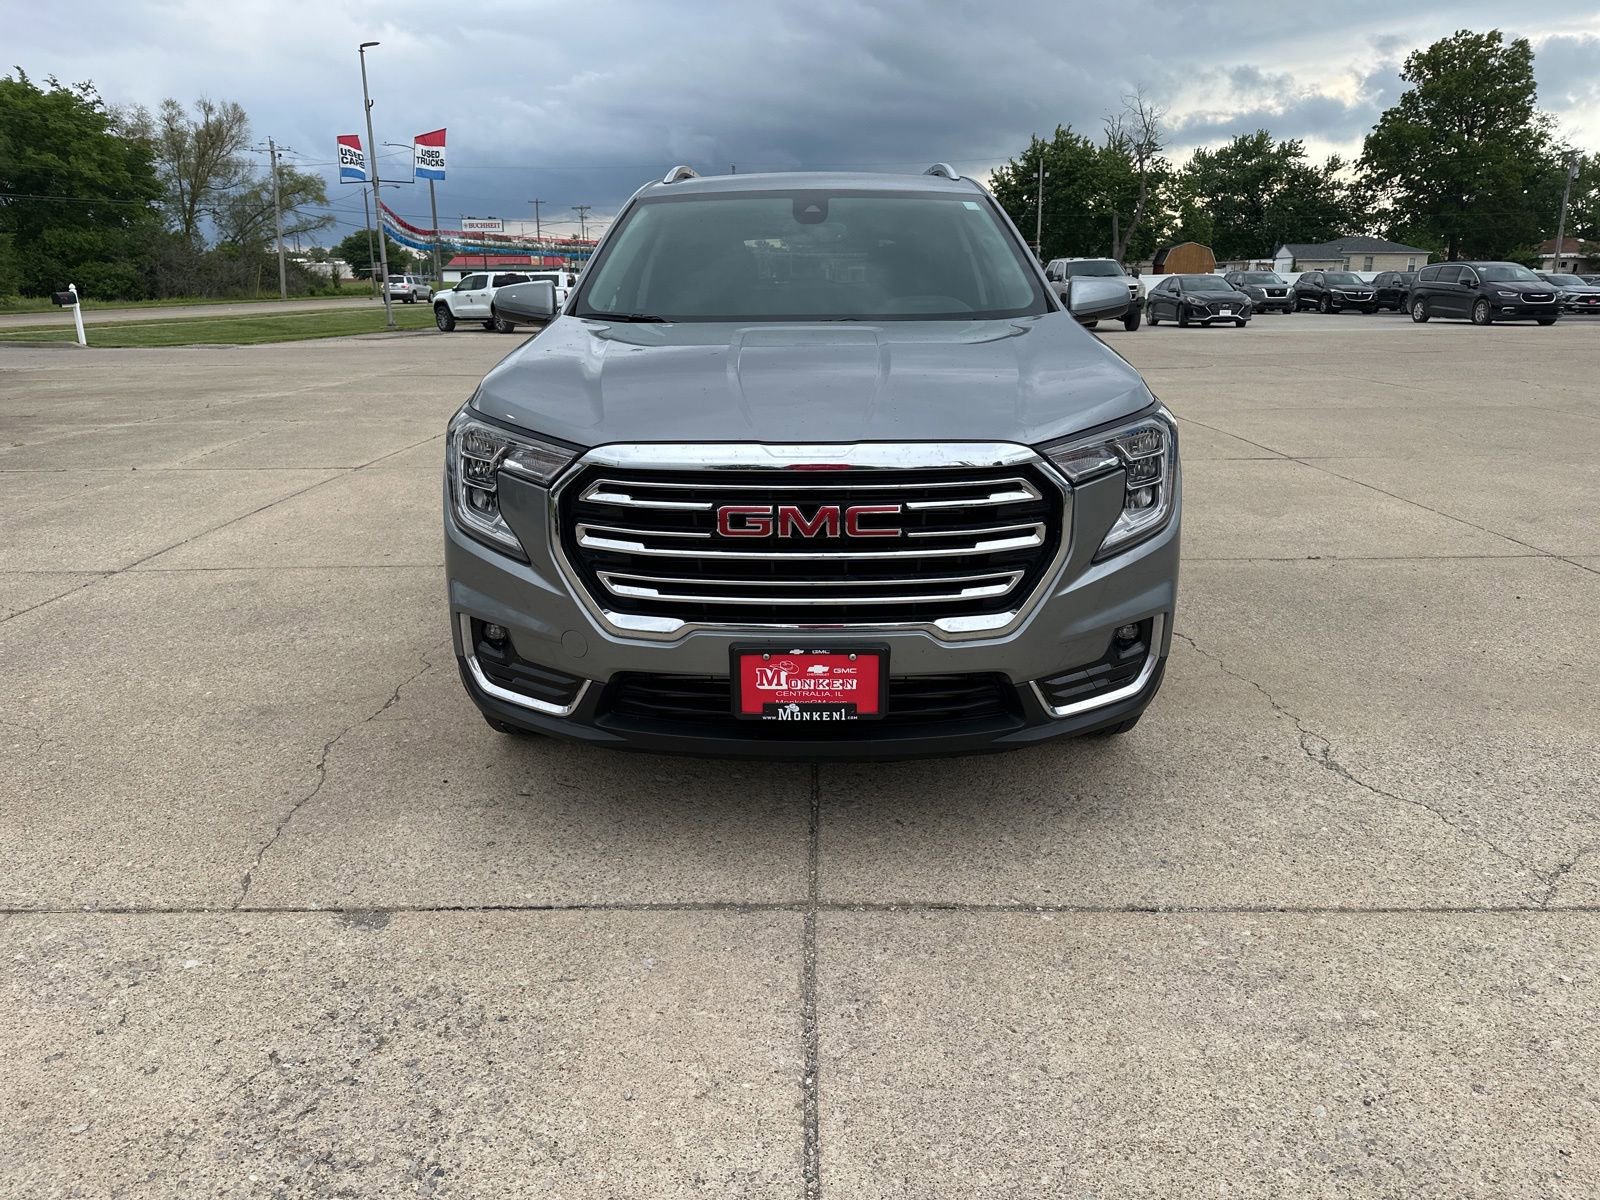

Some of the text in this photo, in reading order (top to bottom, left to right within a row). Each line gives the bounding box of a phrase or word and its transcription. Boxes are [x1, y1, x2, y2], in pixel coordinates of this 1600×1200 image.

[340, 148, 364, 161] USED
[421, 149, 440, 158] USED
[341, 156, 365, 169] CARS
[416, 156, 445, 167] TRUCKS
[717, 505, 903, 538] GMC
[756, 668, 857, 690] MONKEN
